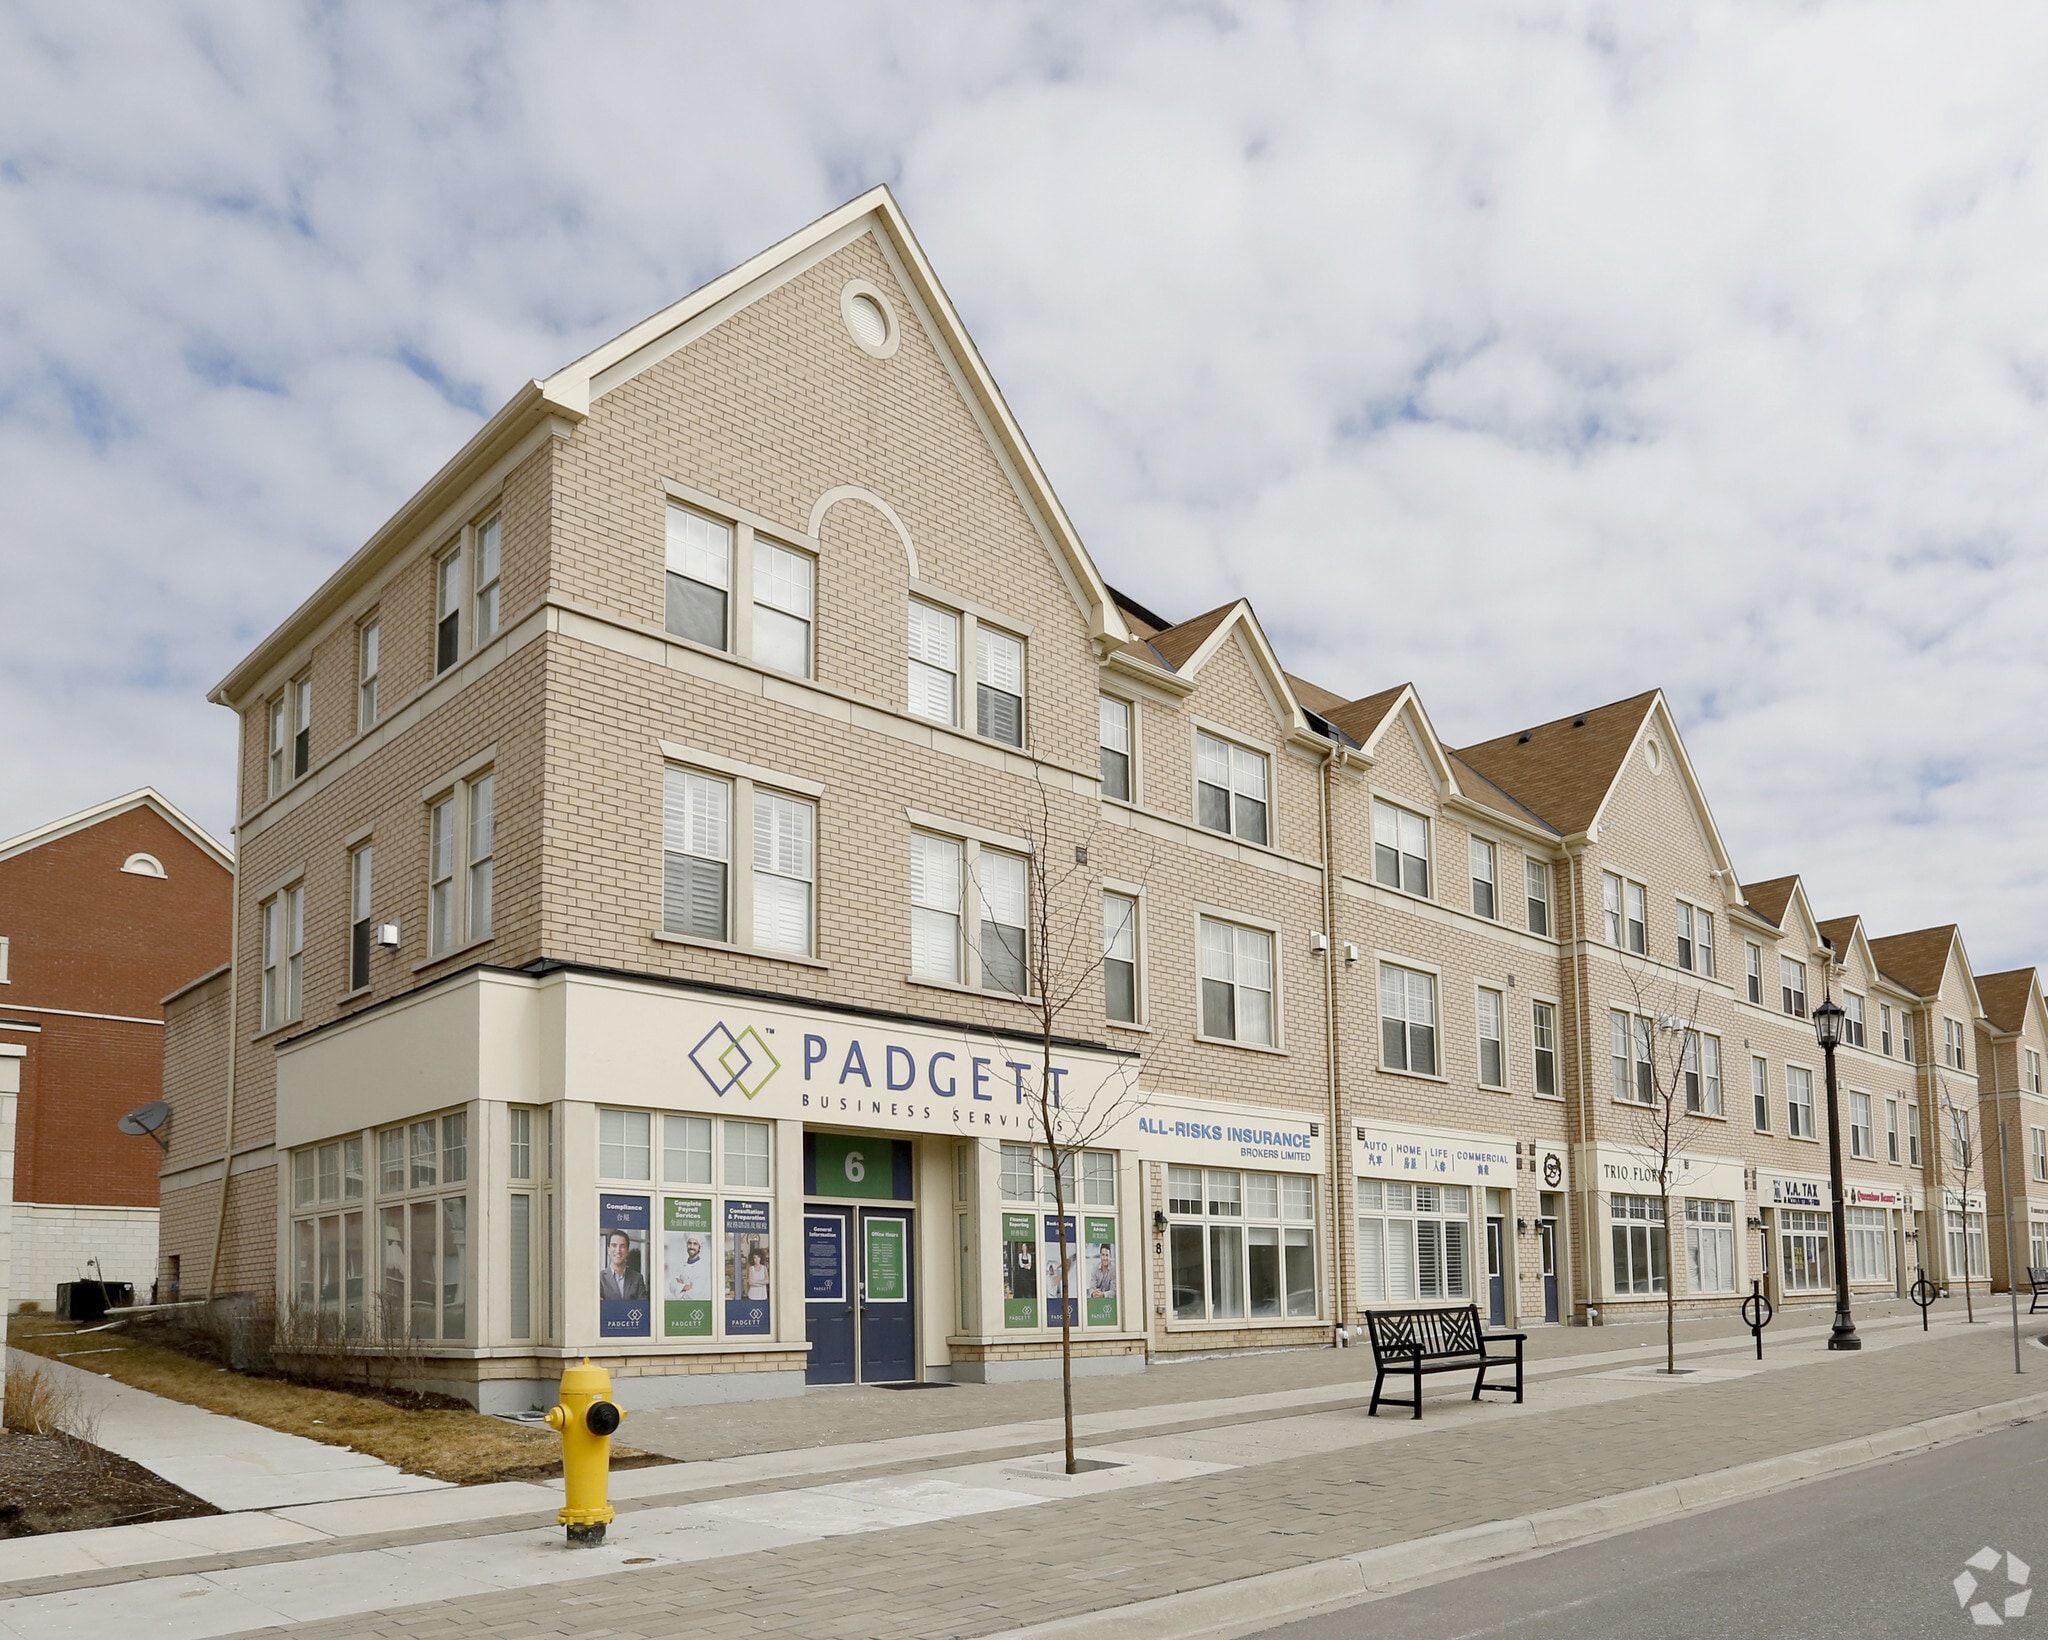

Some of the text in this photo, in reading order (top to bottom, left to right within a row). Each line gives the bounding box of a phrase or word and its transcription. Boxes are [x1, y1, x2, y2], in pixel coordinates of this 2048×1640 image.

[804, 1033, 1069, 1108] PADGETT
[802, 1093, 1064, 1132] BUSINESS SERVICS
[1139, 1116, 1311, 1149] ALL-RISKS INSURANCE
[1363, 1140, 1388, 1153] AUTO
[1396, 1143, 1422, 1156] HOME
[1430, 1147, 1448, 1159] LIFE
[1240, 1147, 1311, 1162] BROKERS LIMITED
[1457, 1150, 1508, 1165] COMMERCIAL
[845, 1151, 865, 1183] 6
[1785, 1180, 1818, 1198] V.A. TAX
[606, 1203, 643, 1212] Compliance
[674, 1200, 702, 1208] Complete
[1155, 1242, 1162, 1255] 8
